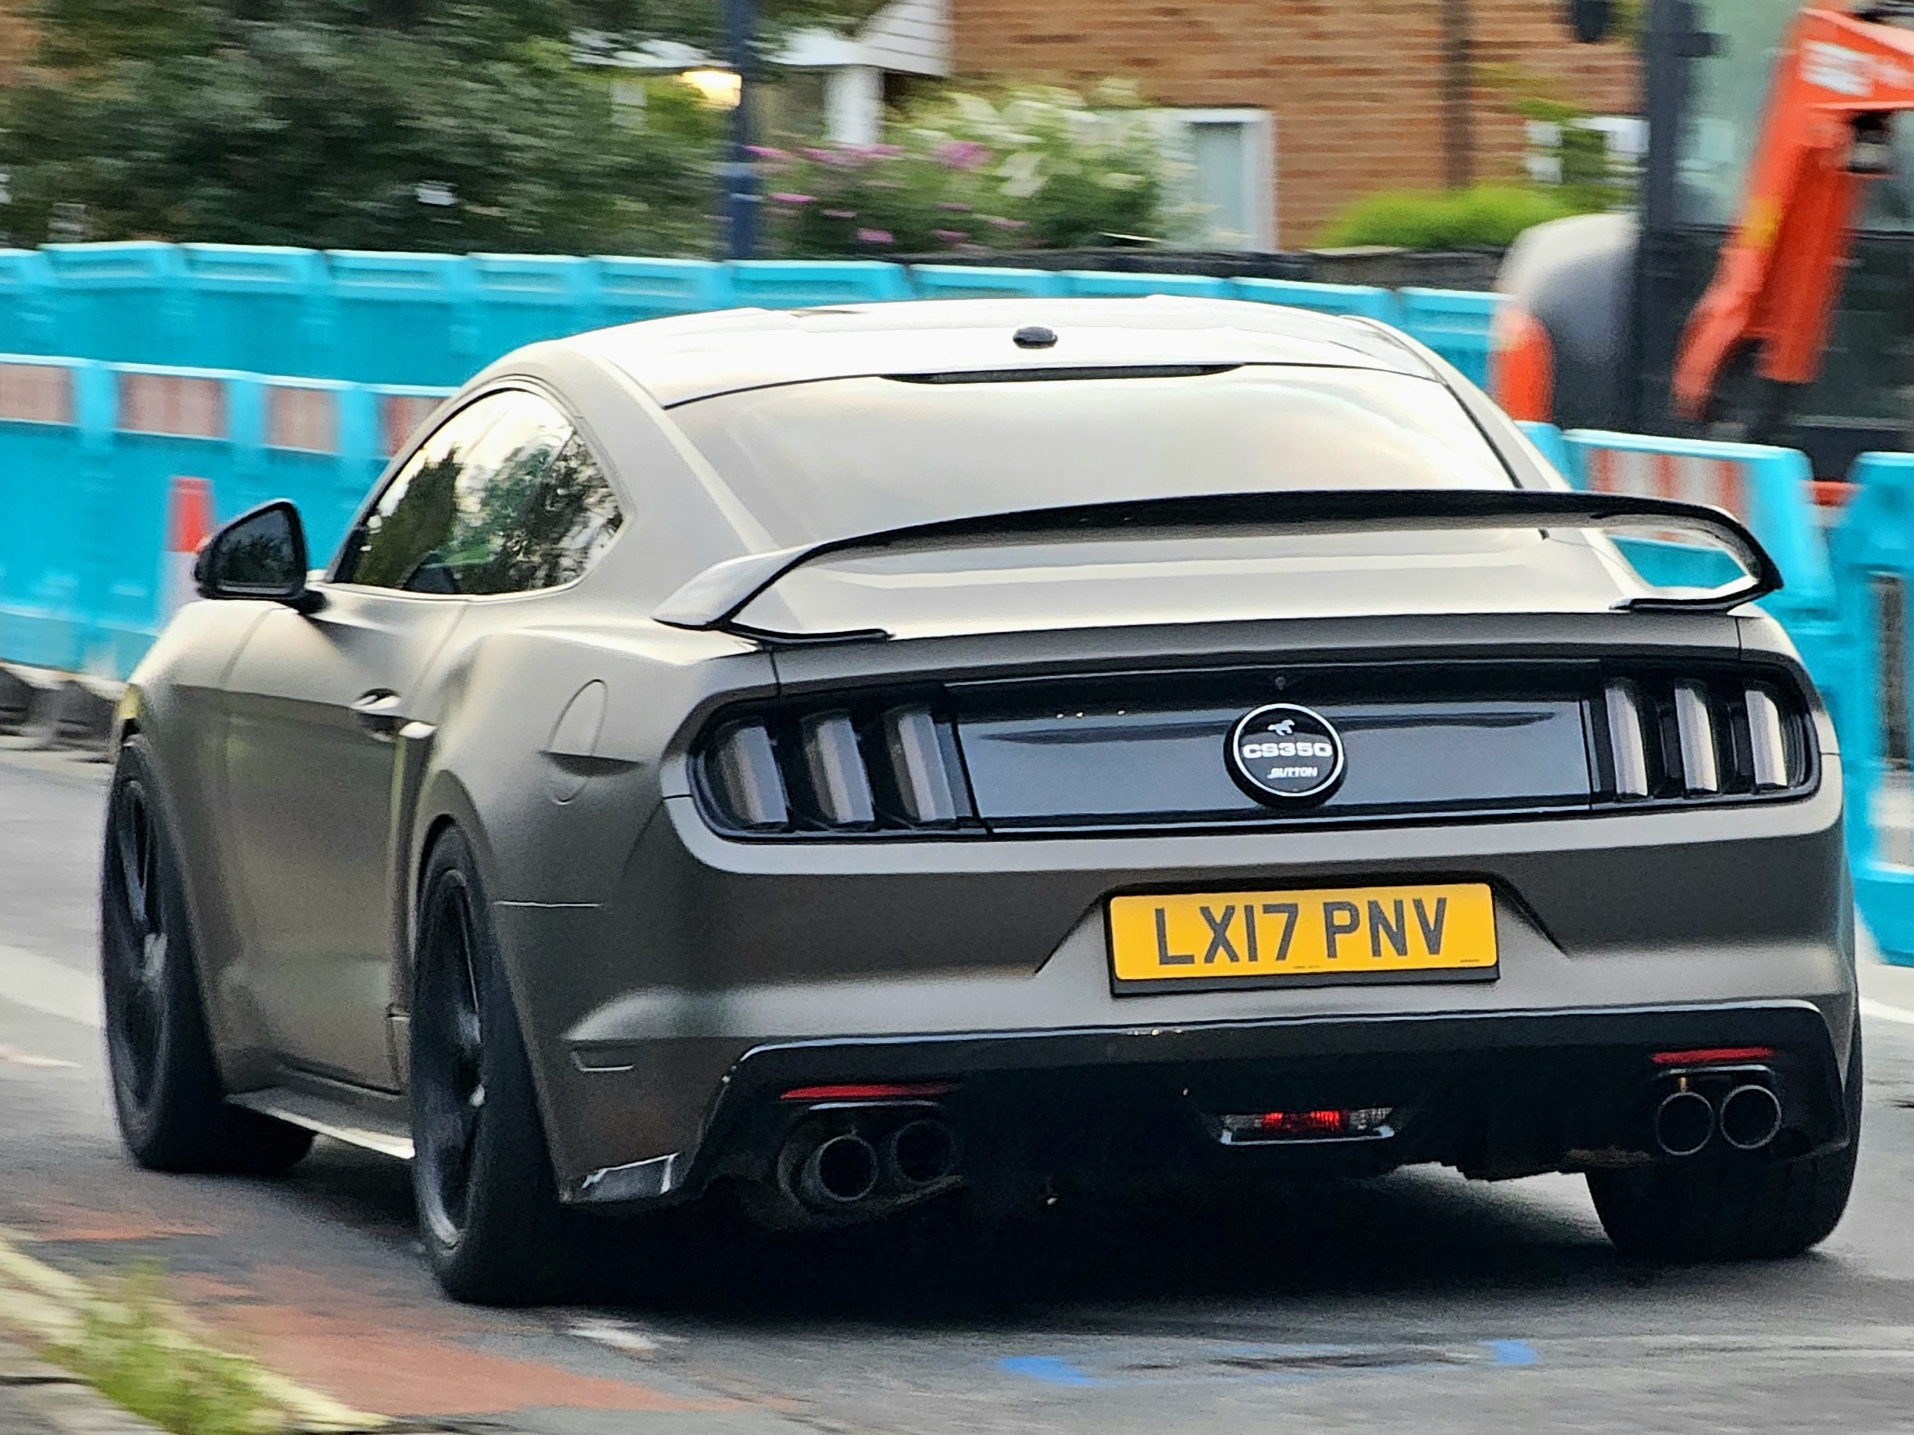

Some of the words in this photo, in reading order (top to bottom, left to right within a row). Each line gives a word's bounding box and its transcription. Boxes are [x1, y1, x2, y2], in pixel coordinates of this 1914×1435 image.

[1242, 741, 1333, 759] CS350
[1267, 766, 1318, 779] SUTTON
[1154, 902, 1299, 966] LX17
[1323, 897, 1447, 959] PNV
